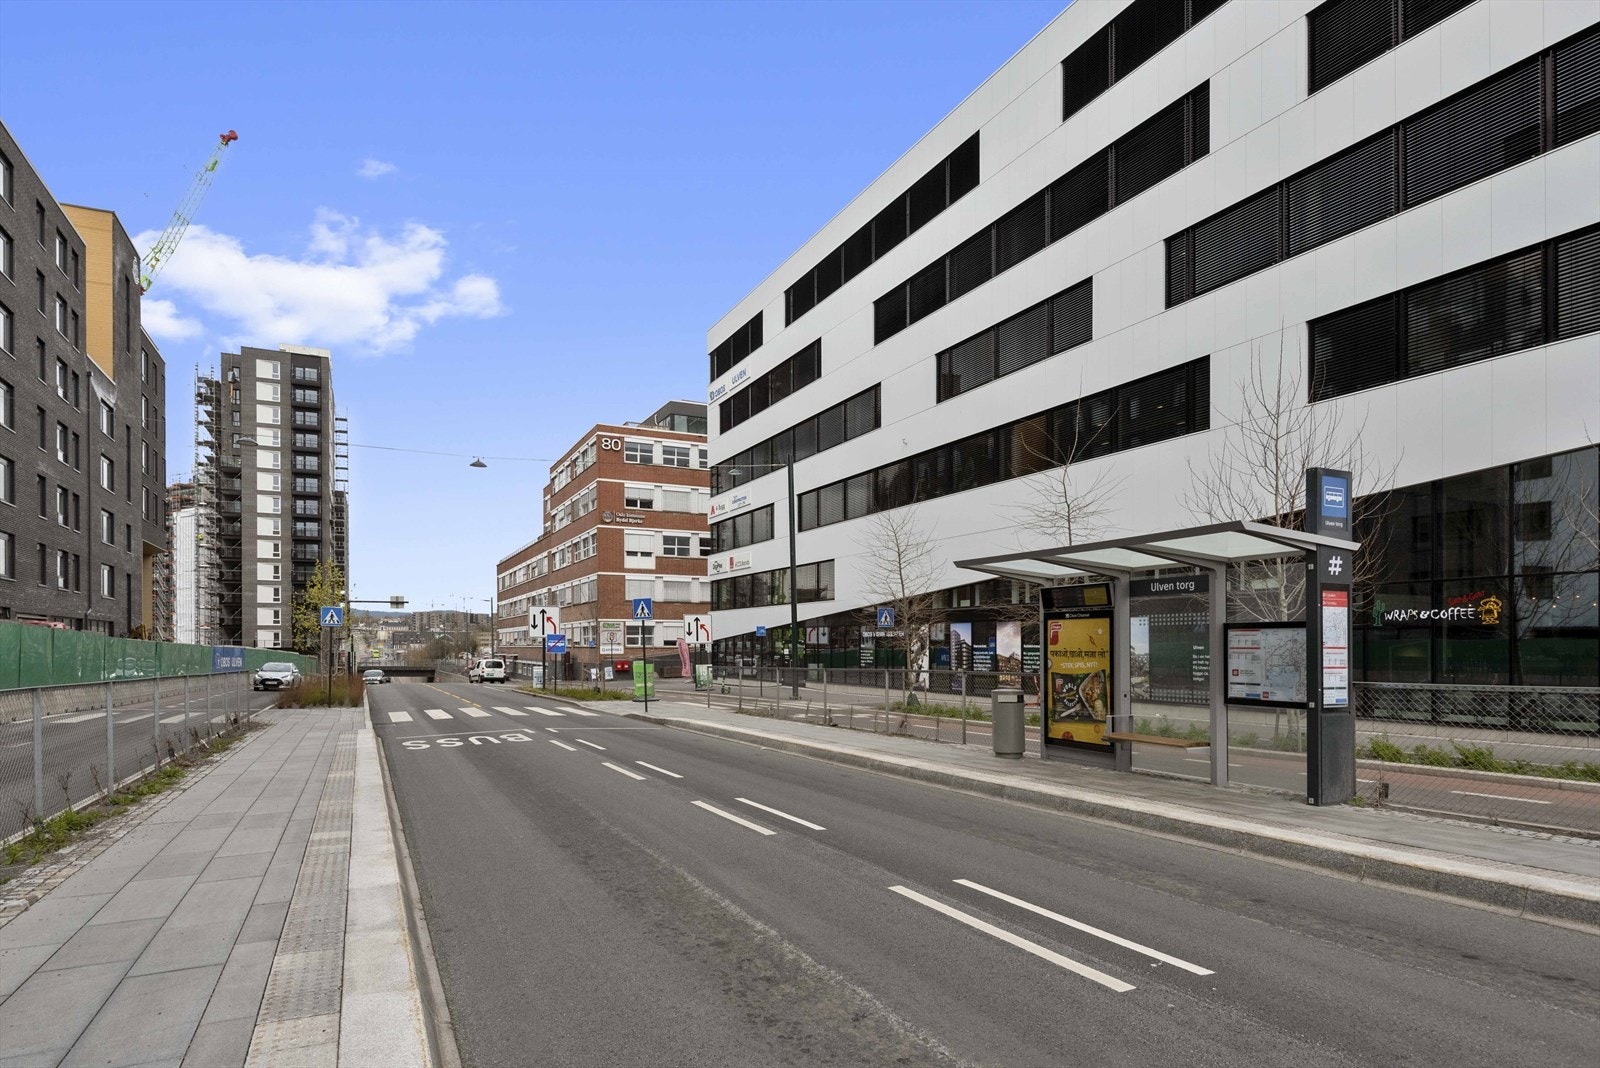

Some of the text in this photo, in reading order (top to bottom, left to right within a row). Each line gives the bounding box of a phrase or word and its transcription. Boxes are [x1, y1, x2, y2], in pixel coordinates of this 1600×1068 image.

[732, 368, 747, 385] ULVEN
[601, 438, 621, 451] 80
[1151, 581, 1195, 591] Ulven torg
[402, 733, 533, 750] BUSS
